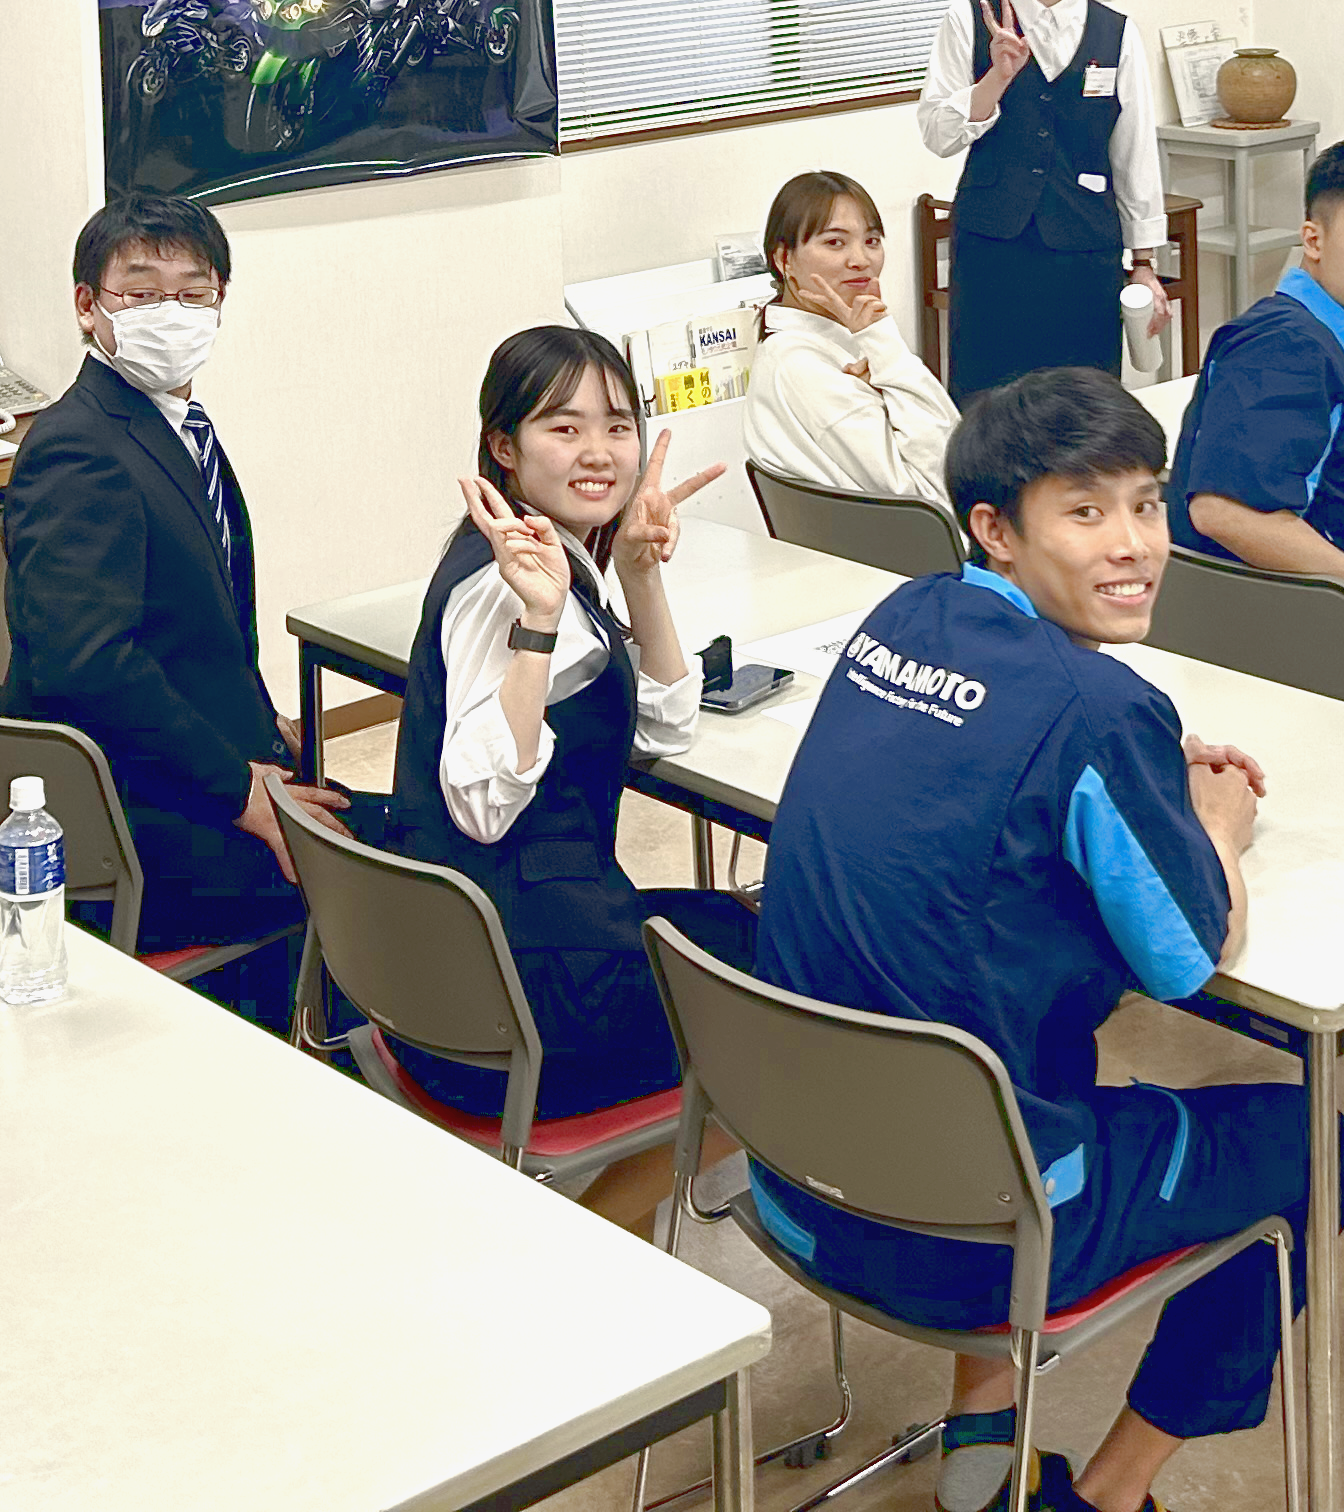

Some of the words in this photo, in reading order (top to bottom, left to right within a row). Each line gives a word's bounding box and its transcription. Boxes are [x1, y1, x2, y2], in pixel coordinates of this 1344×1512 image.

[699, 328, 737, 347] KANSAI
[855, 634, 987, 710] YAMAMOTO
[928, 704, 964, 727] Future
